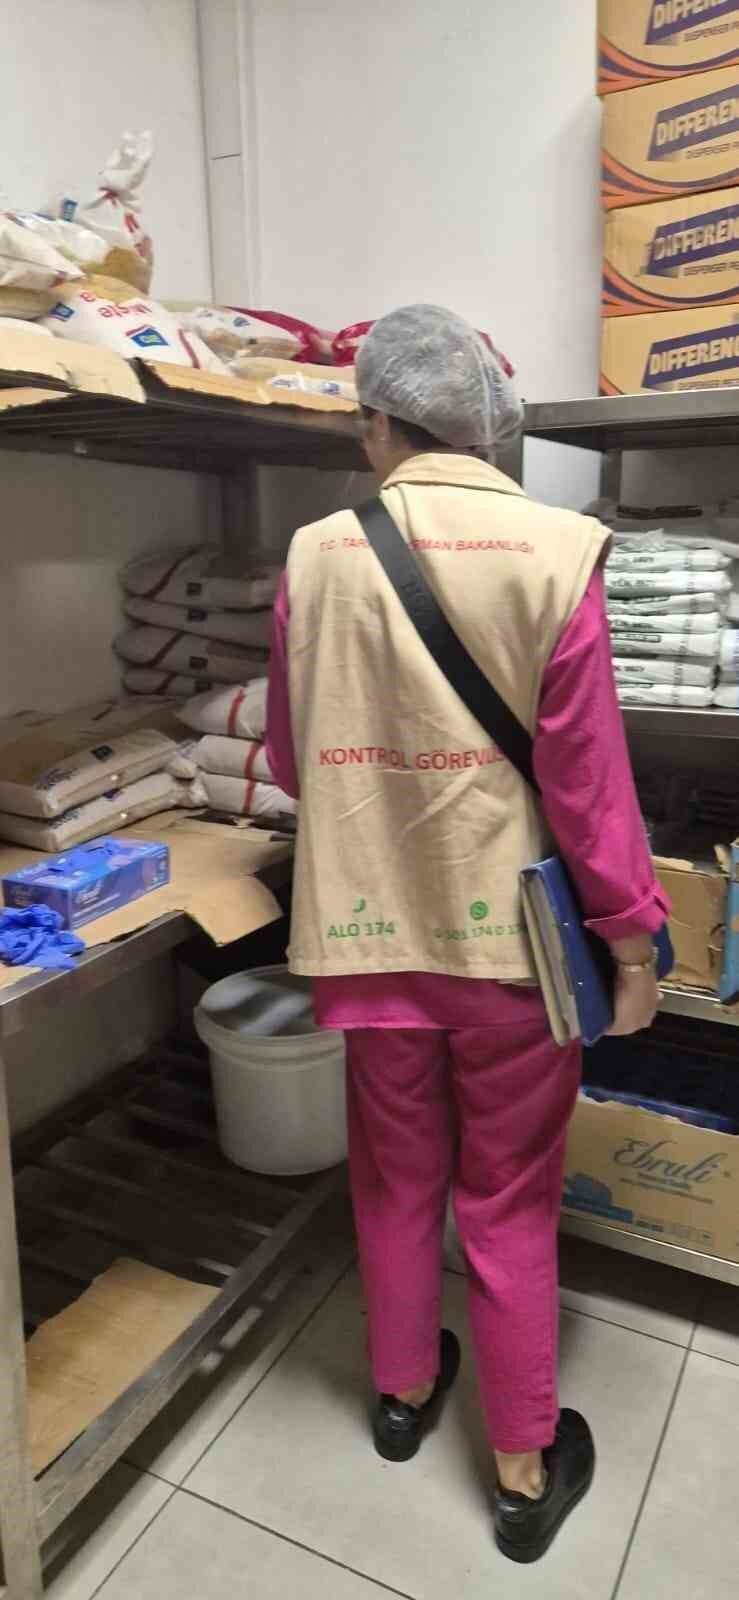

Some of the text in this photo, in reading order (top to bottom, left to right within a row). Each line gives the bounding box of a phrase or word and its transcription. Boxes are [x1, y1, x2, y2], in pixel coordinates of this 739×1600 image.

[649, 336, 739, 376] DIFFEREN
[343, 536, 368, 550] TAR
[319, 747, 410, 769] KONTROL
[327, 921, 395, 938] ALO 174
